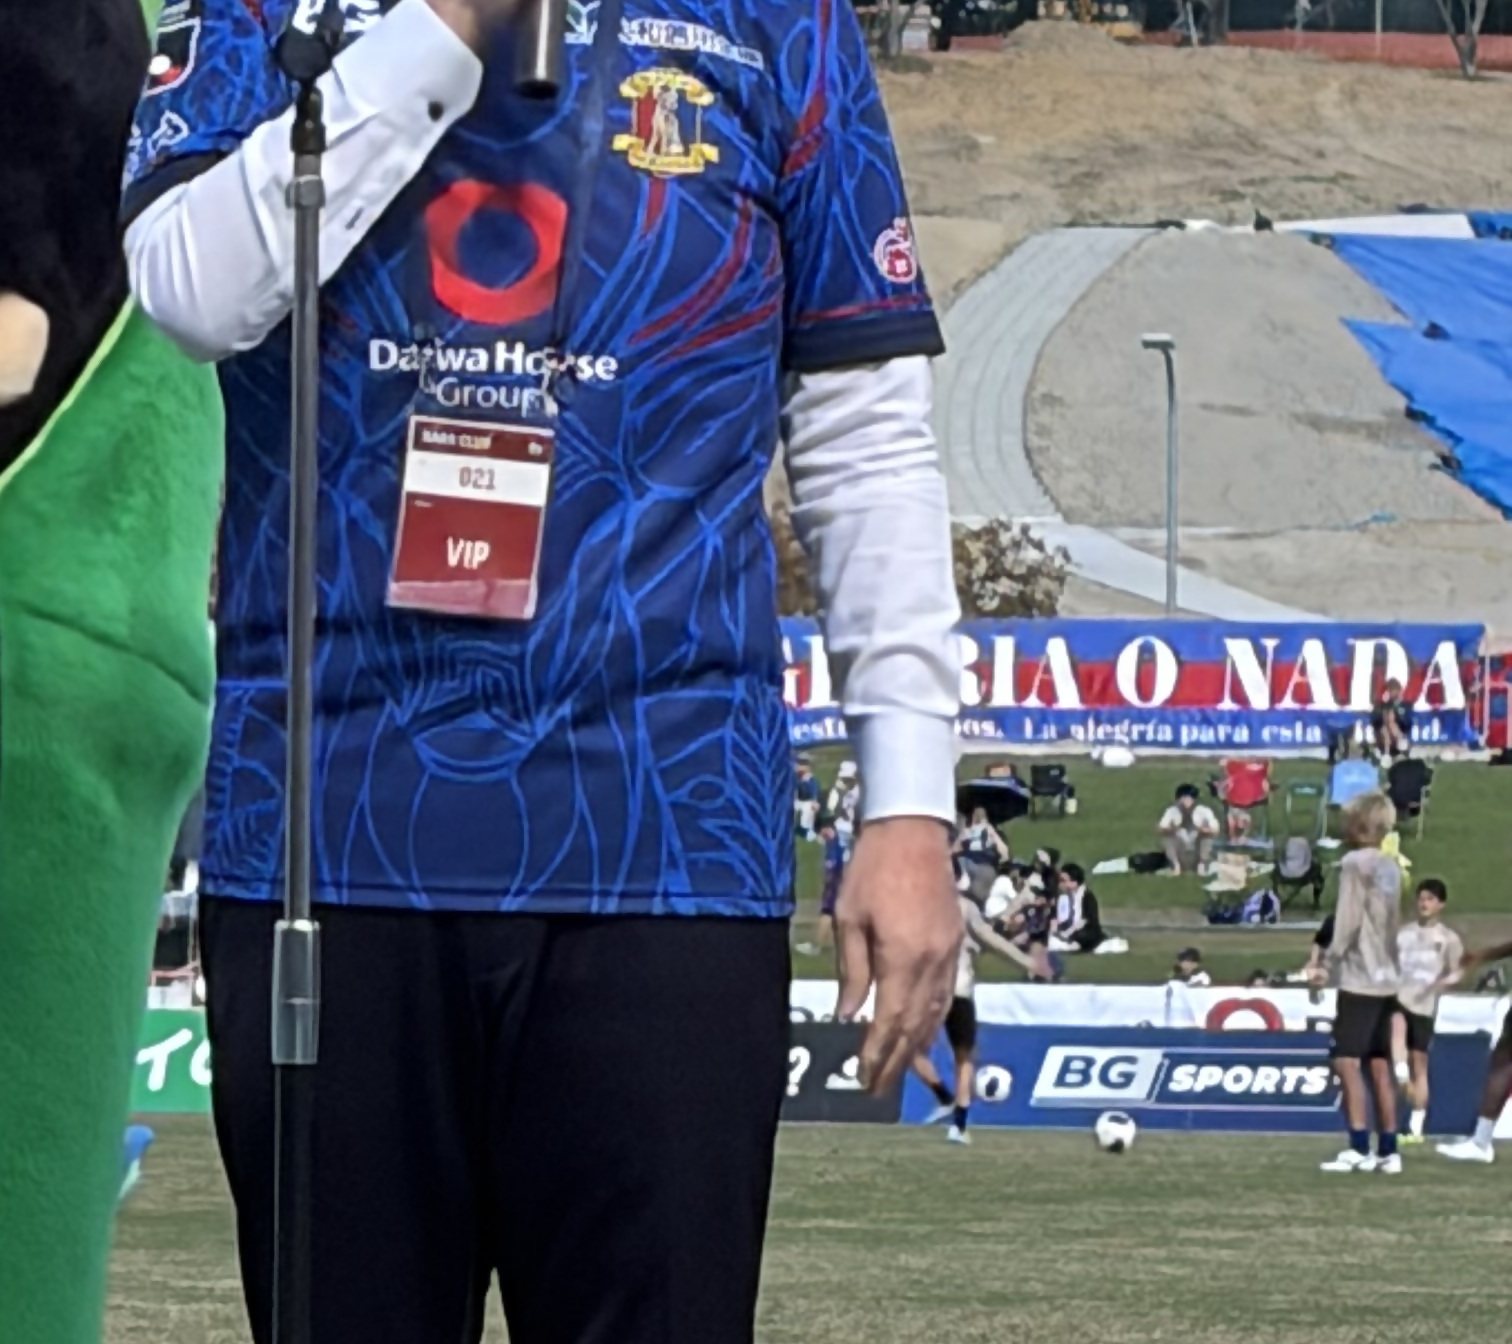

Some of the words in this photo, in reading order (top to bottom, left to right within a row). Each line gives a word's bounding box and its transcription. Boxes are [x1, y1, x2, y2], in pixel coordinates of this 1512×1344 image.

[369, 338, 488, 373] Dawa
[495, 341, 618, 381] Hose
[436, 376, 544, 418] Group
[459, 466, 496, 490] 021
[446, 537, 491, 569] VIP
[1116, 635, 1178, 709] O
[1217, 636, 1466, 711] NADA
[1180, 723, 1250, 746] para
[1053, 1054, 1139, 1090] BG
[1168, 1063, 1330, 1095] SPORTS
